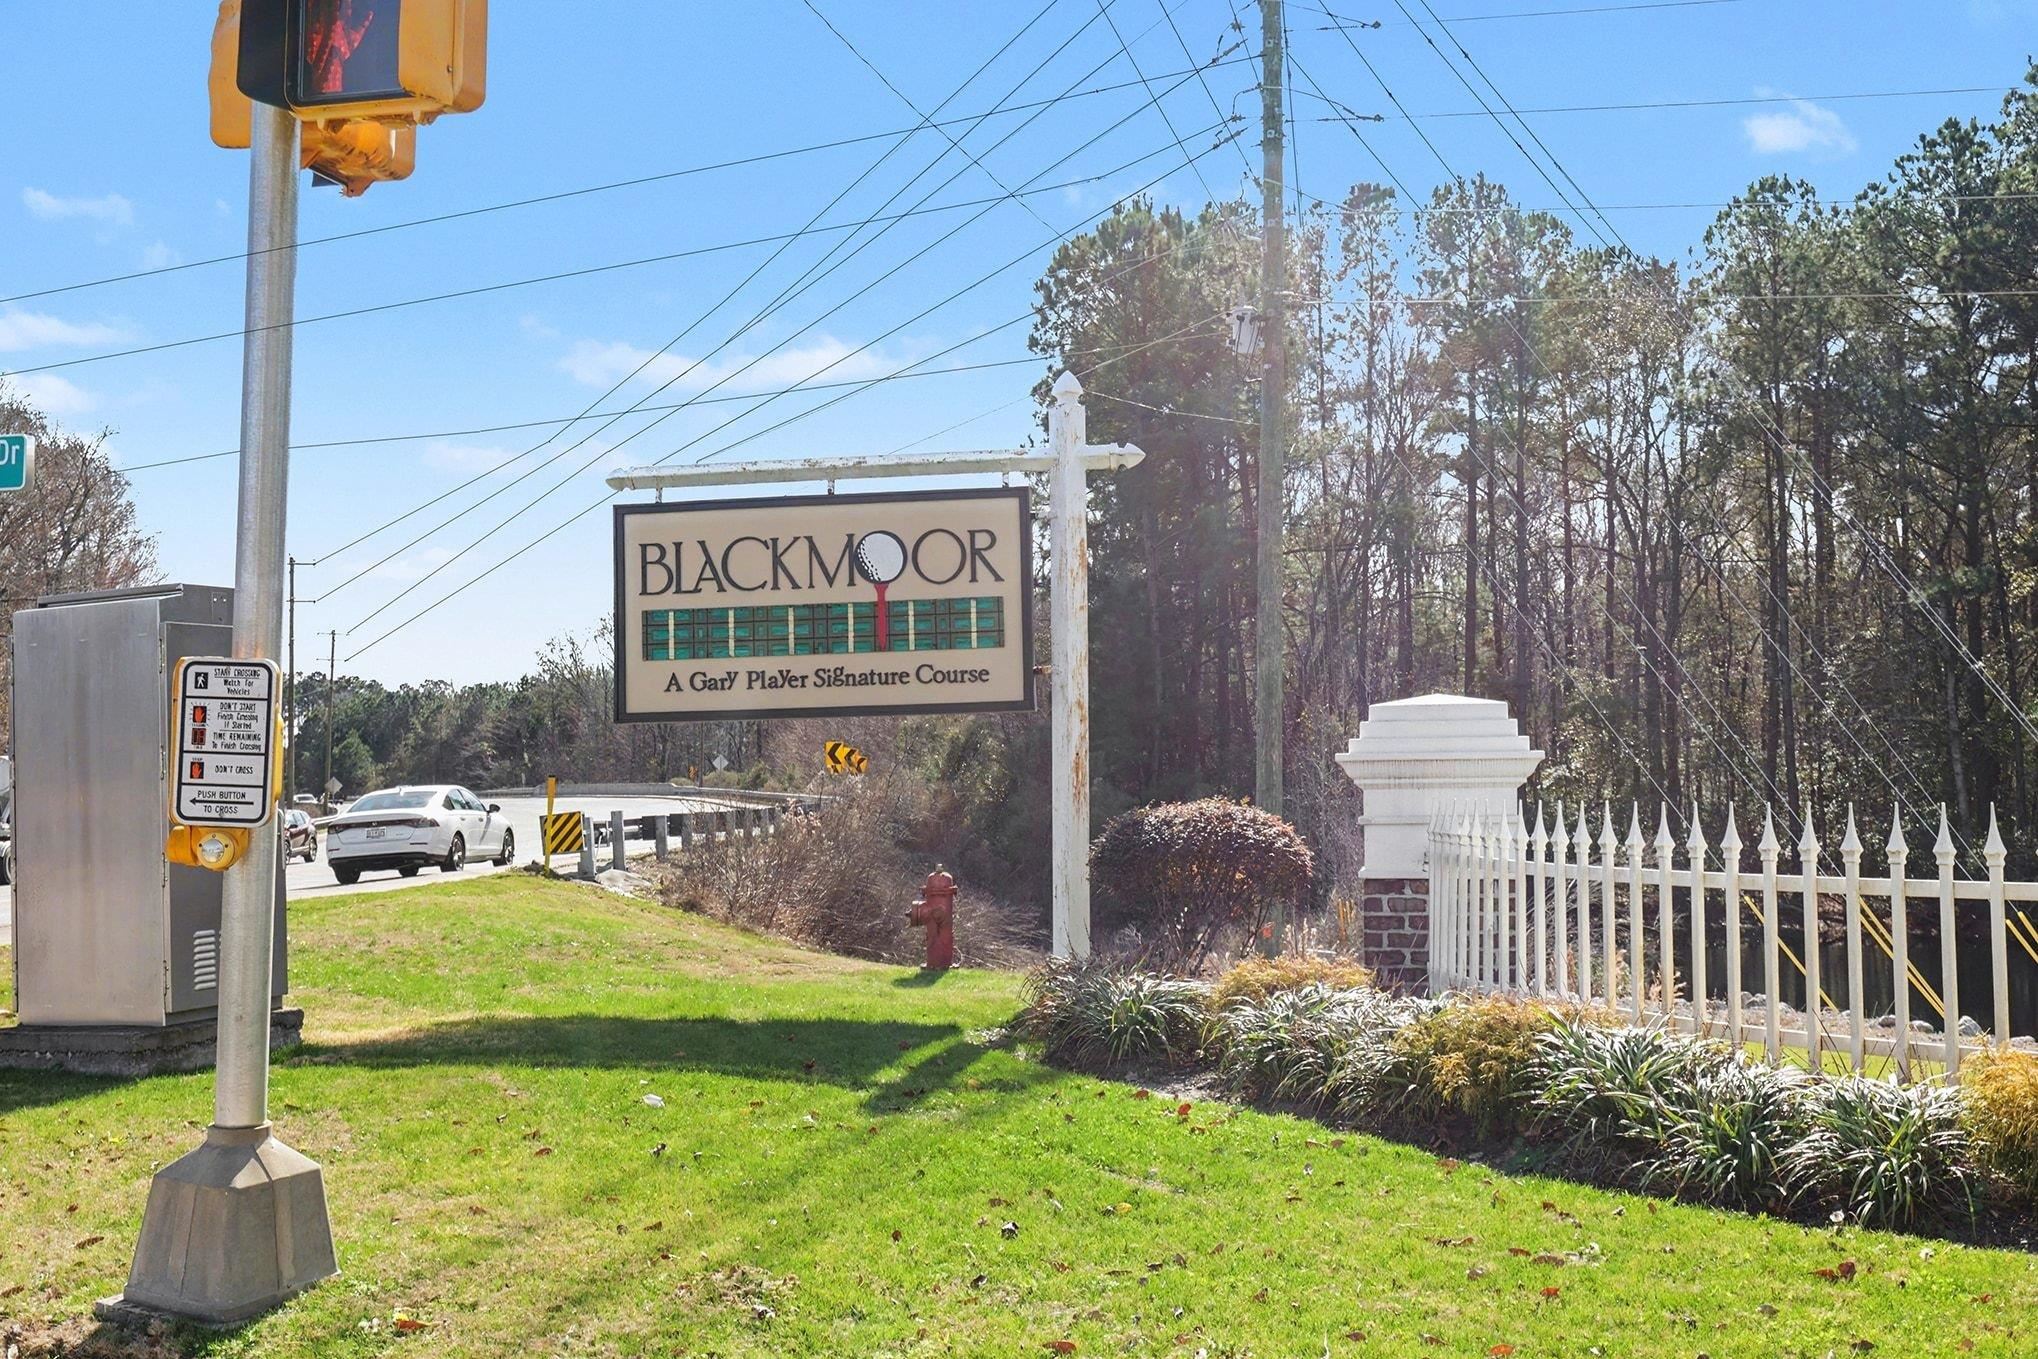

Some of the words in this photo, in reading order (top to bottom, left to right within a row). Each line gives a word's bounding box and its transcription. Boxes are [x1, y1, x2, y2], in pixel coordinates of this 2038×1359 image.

[638, 528, 1004, 596] BLACKMOOR
[664, 672, 684, 693] A
[690, 669, 738, 692] Gary
[746, 668, 807, 690] Player
[813, 665, 910, 688] Signature
[915, 663, 990, 685] Course
[213, 732, 226, 740] TIME
[229, 733, 261, 741] REMAINING
[214, 765, 233, 773] DON'T
[235, 765, 254, 774] CROSS
[197, 790, 216, 799] PUSH
[219, 791, 247, 800] BUTTON
[203, 805, 212, 813] TO
[214, 805, 239, 814] CROSS
